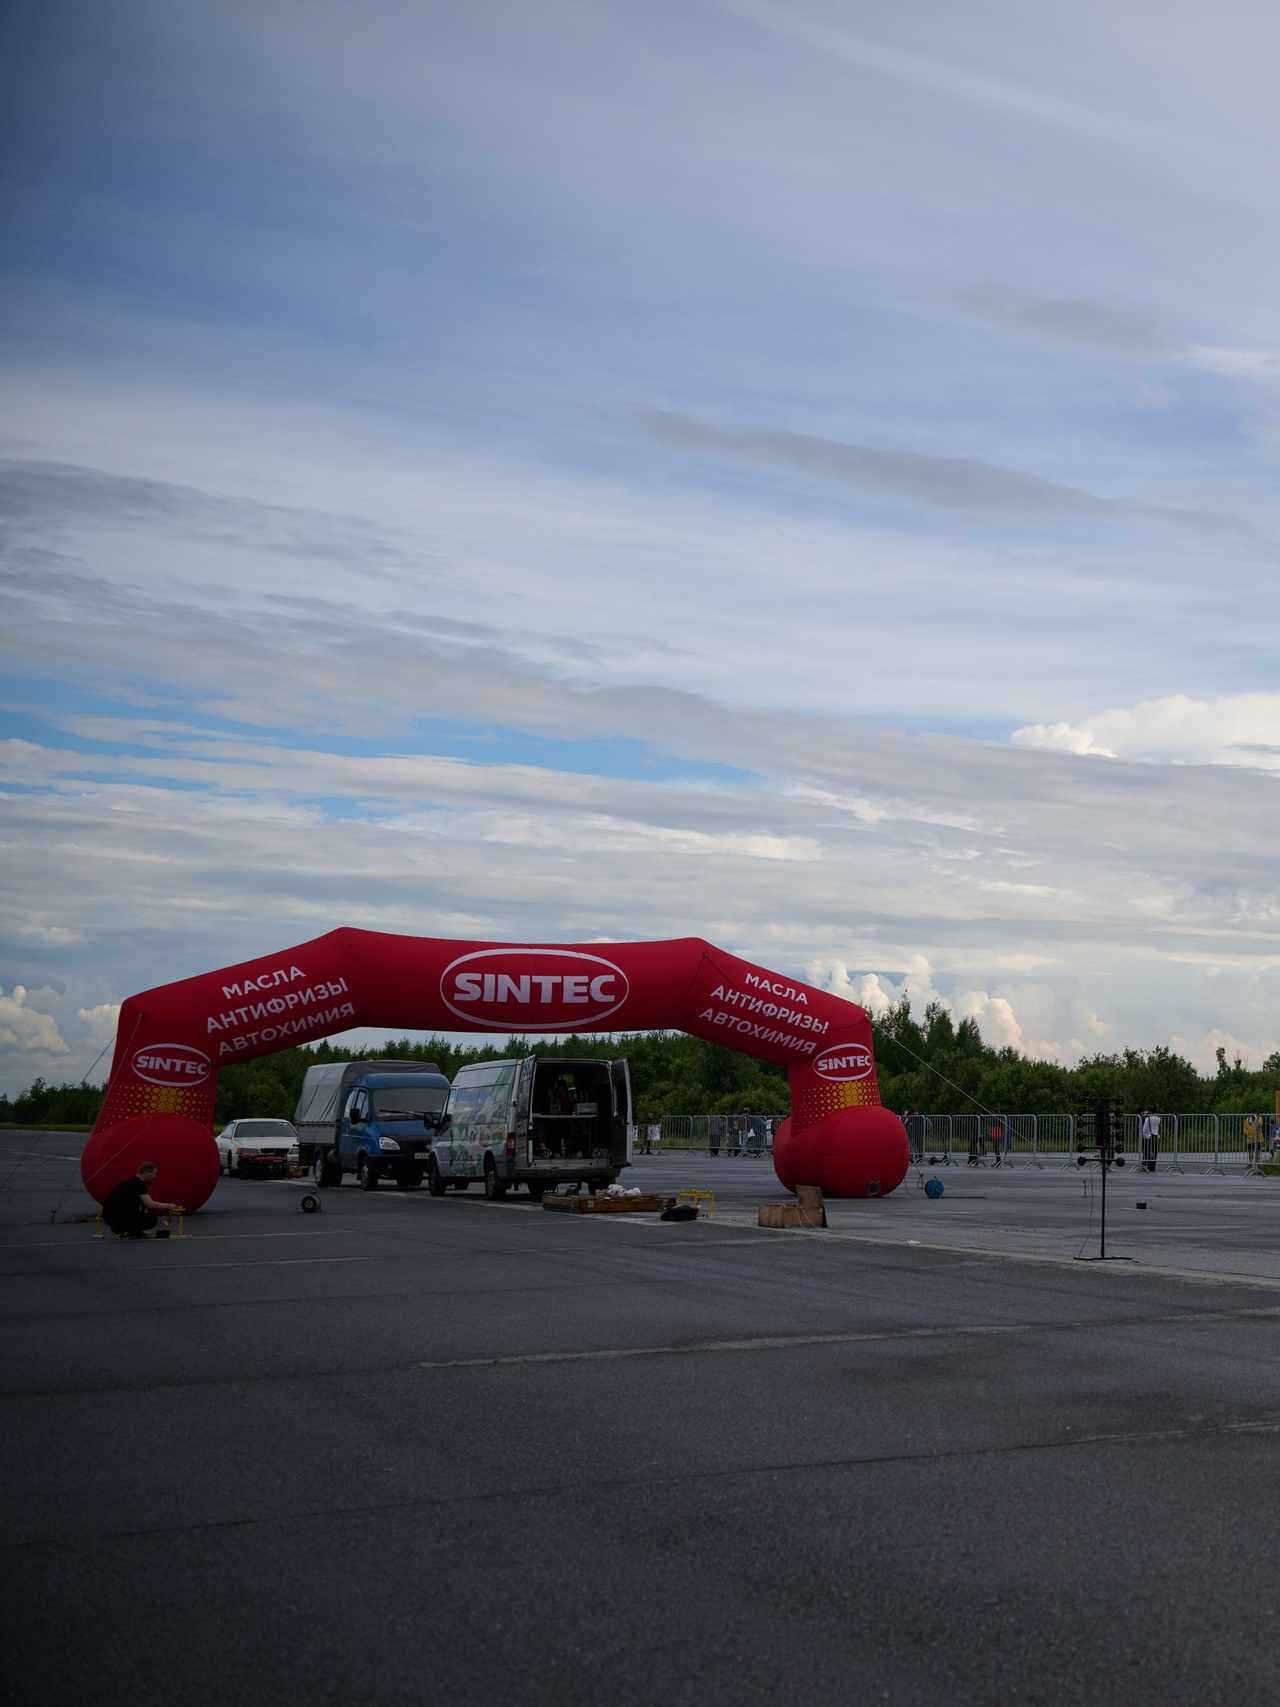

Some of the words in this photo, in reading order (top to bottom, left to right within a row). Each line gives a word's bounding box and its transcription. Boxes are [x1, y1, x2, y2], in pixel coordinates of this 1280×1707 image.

[222, 966, 306, 999] МАСЛА
[453, 973, 616, 1004] SINTEC
[744, 972, 808, 1005] МАСЛА
[206, 977, 349, 1034] АНТИФРИЗЫ
[710, 985, 830, 1034] АНТИФРИЗЫ
[218, 1002, 355, 1056] АВТОХИМИЯ
[698, 1007, 817, 1055] АВТОХИМИЯ
[136, 1055, 209, 1076] SINTEC
[817, 1055, 871, 1072] SINTEC
